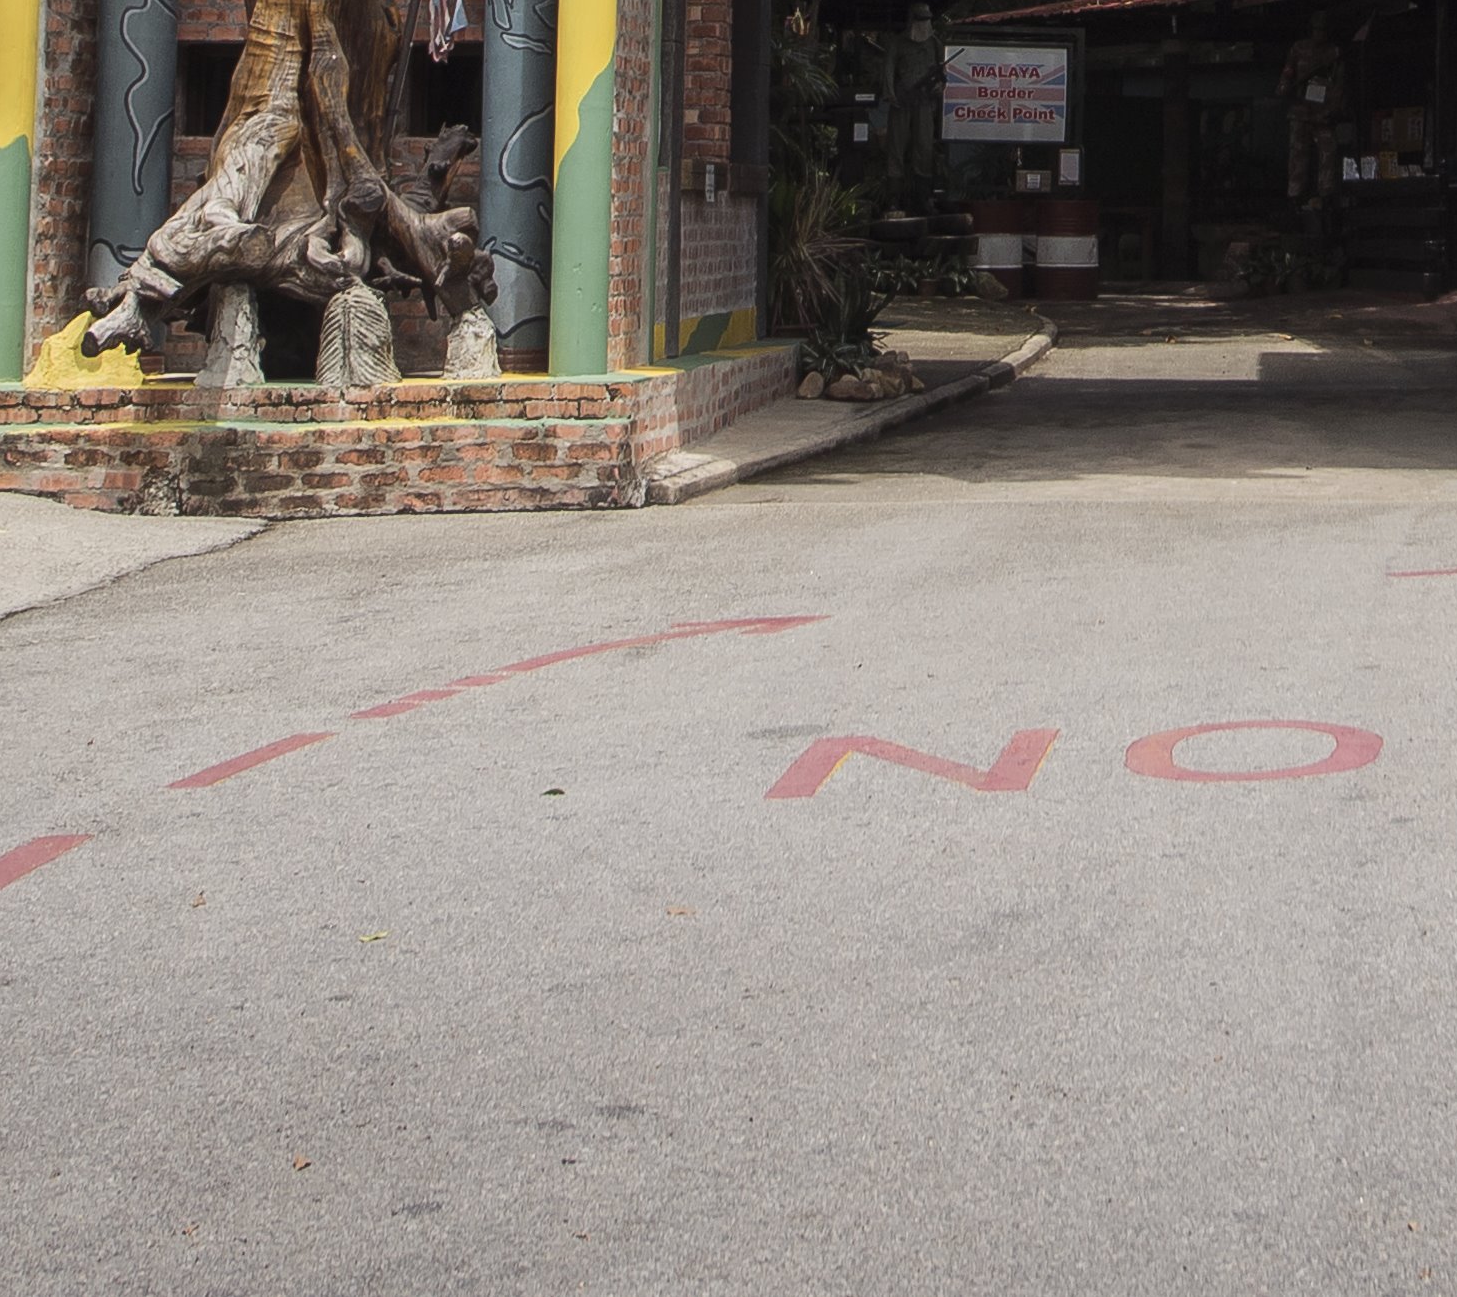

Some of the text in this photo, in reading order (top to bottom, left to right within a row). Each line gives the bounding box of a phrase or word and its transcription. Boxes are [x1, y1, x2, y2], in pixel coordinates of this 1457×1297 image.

[970, 66, 1041, 80] MALAYA
[977, 87, 1035, 101] Border
[1012, 107, 1056, 121] Point
[763, 718, 1385, 800] NO
